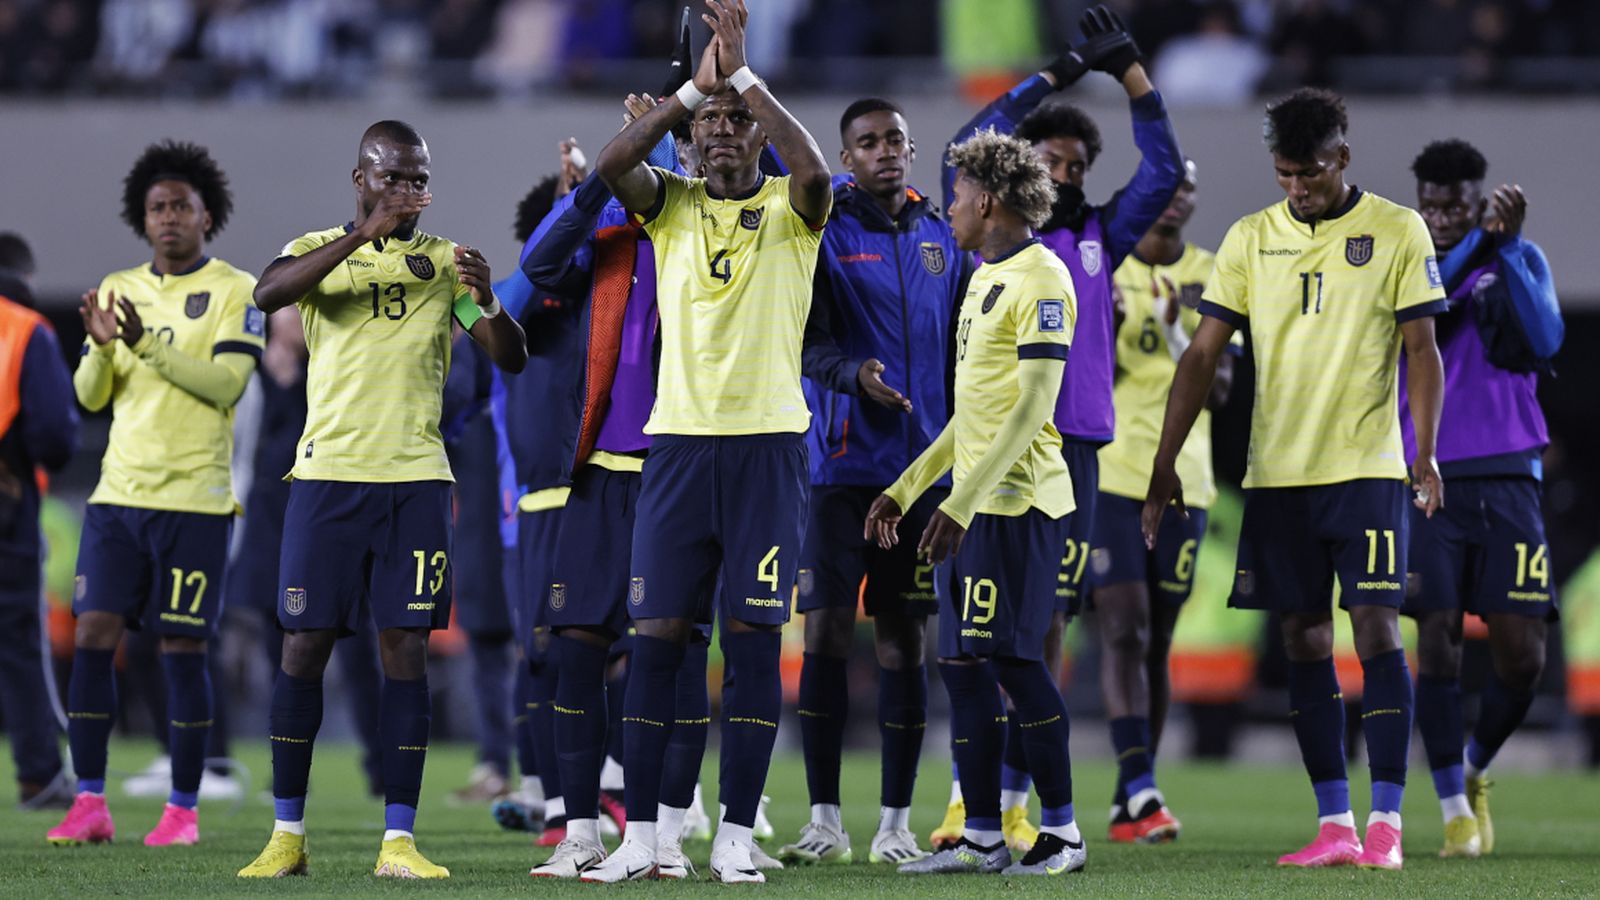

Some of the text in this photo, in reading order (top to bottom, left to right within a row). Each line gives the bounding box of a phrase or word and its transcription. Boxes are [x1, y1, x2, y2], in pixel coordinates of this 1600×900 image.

[347, 259, 375, 268] athon
[710, 249, 732, 285] 4
[1258, 248, 1302, 256] marathon
[368, 282, 407, 321] 13
[1299, 272, 1323, 315] 11
[1138, 317, 1159, 353] 6
[413, 550, 447, 596] 13
[757, 545, 780, 592] 4
[1174, 538, 1197, 582] 6
[1364, 529, 1395, 575] 11
[1514, 542, 1548, 589] 14
[171, 567, 207, 614] 17
[962, 576, 998, 624] 19
[1356, 580, 1401, 591] marathon
[376, 861, 419, 879] AIR
